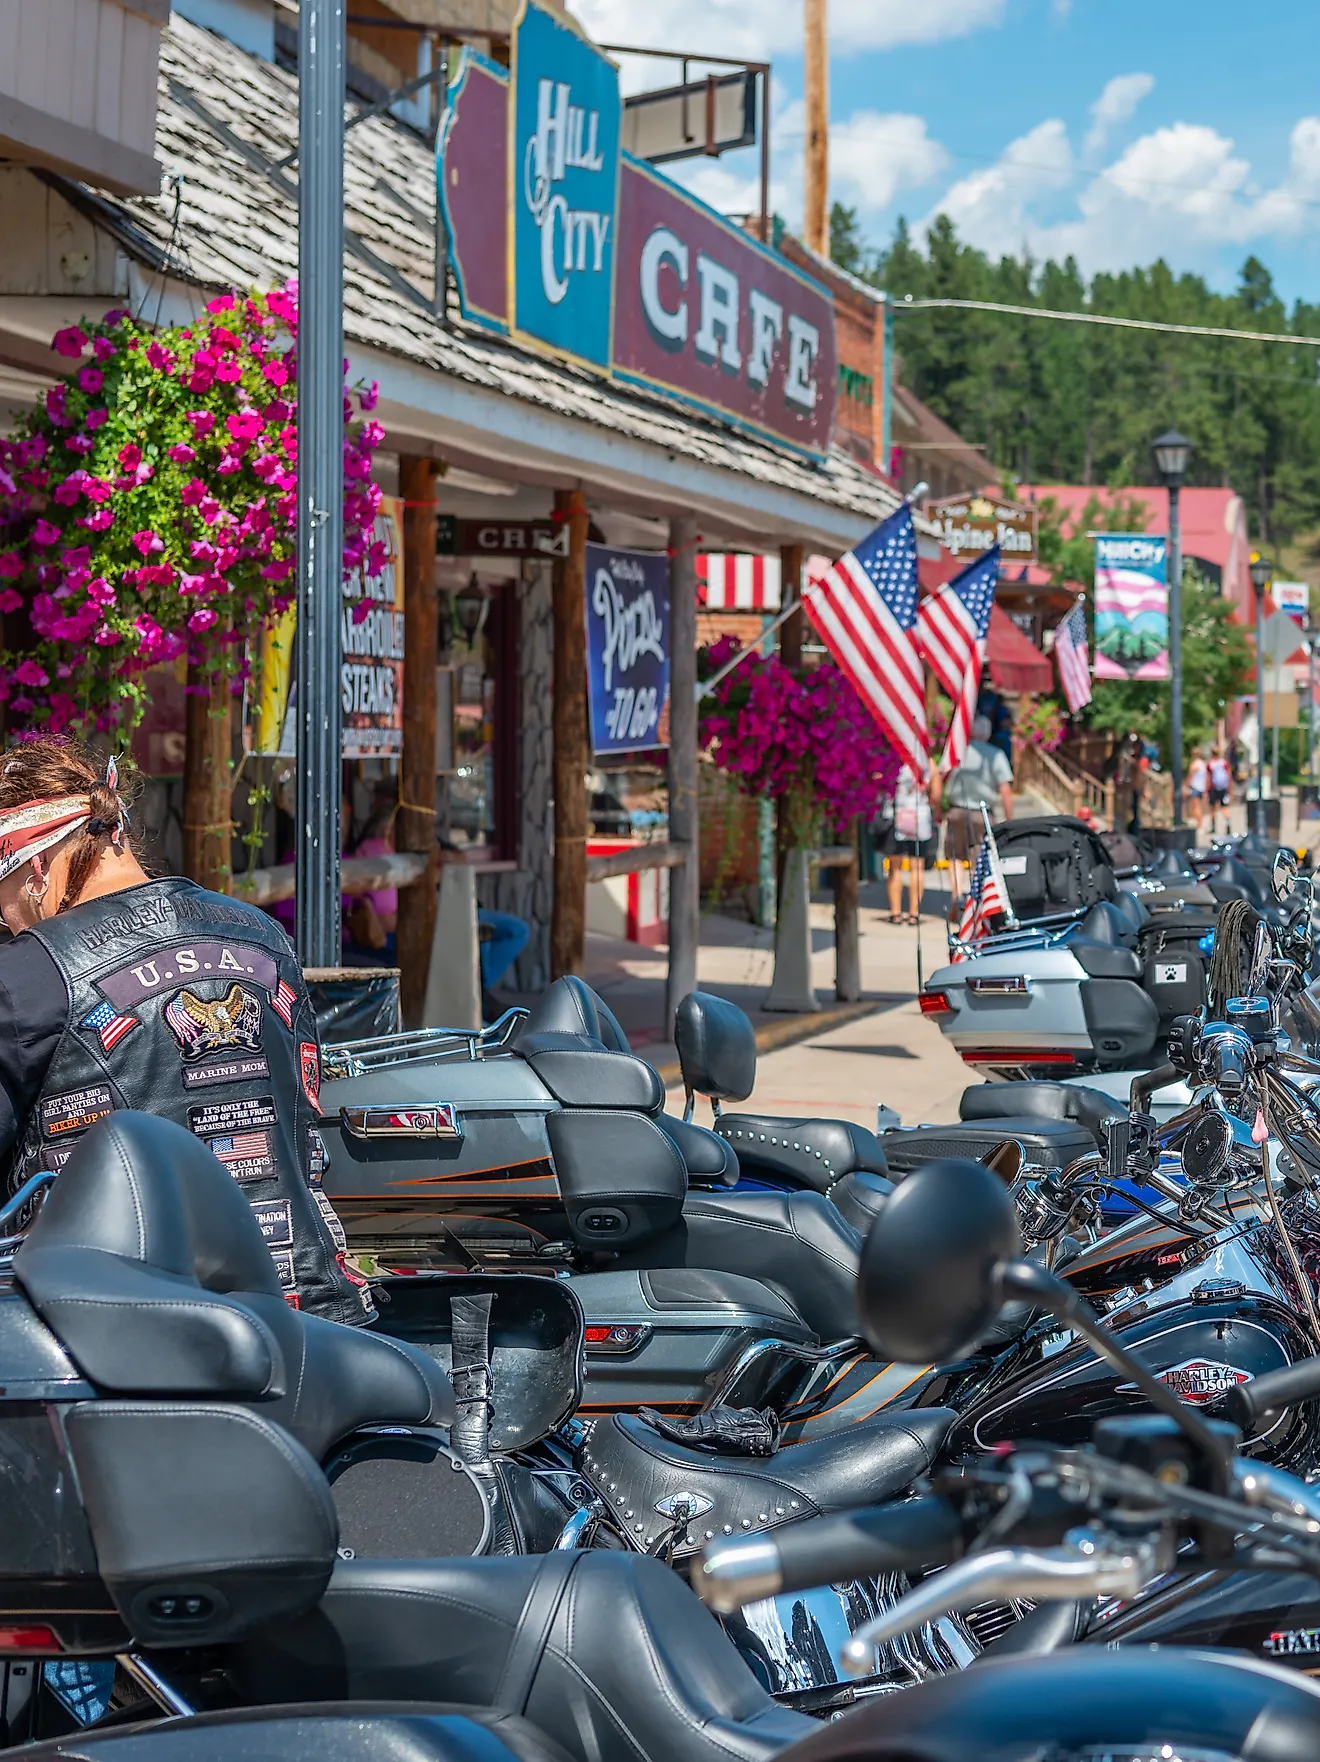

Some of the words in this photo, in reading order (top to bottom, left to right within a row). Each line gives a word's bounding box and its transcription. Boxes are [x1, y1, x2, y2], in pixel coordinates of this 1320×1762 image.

[640, 226, 820, 411] CAFE
[130, 948, 255, 988] U.S.A.
[187, 1066, 237, 1081] MARINE
[241, 1062, 267, 1073] MOM
[44, 1108, 61, 1118] GIRL
[62, 1098, 97, 1113] PANTIES
[98, 1093, 110, 1104] ON
[47, 1099, 62, 1109] PUT
[62, 1093, 86, 1105] YOUR
[86, 1088, 101, 1098] BIG
[221, 1102, 241, 1112] ONLY
[242, 1100, 259, 1110] THE
[48, 1117, 81, 1134] BIKER
[82, 1112, 98, 1125] UP
[67, 1108, 86, 1120] AND
[194, 1120, 226, 1133] BECAUSE
[226, 1119, 237, 1129] OF
[237, 1117, 253, 1127] THE
[253, 1114, 275, 1125] BRAVE
[220, 1113, 231, 1122] OF
[231, 1110, 249, 1120] THE
[238, 1156, 270, 1169] COLORS
[245, 1165, 262, 1176] RUN
[1168, 1378, 1236, 1394] AVIDSON
